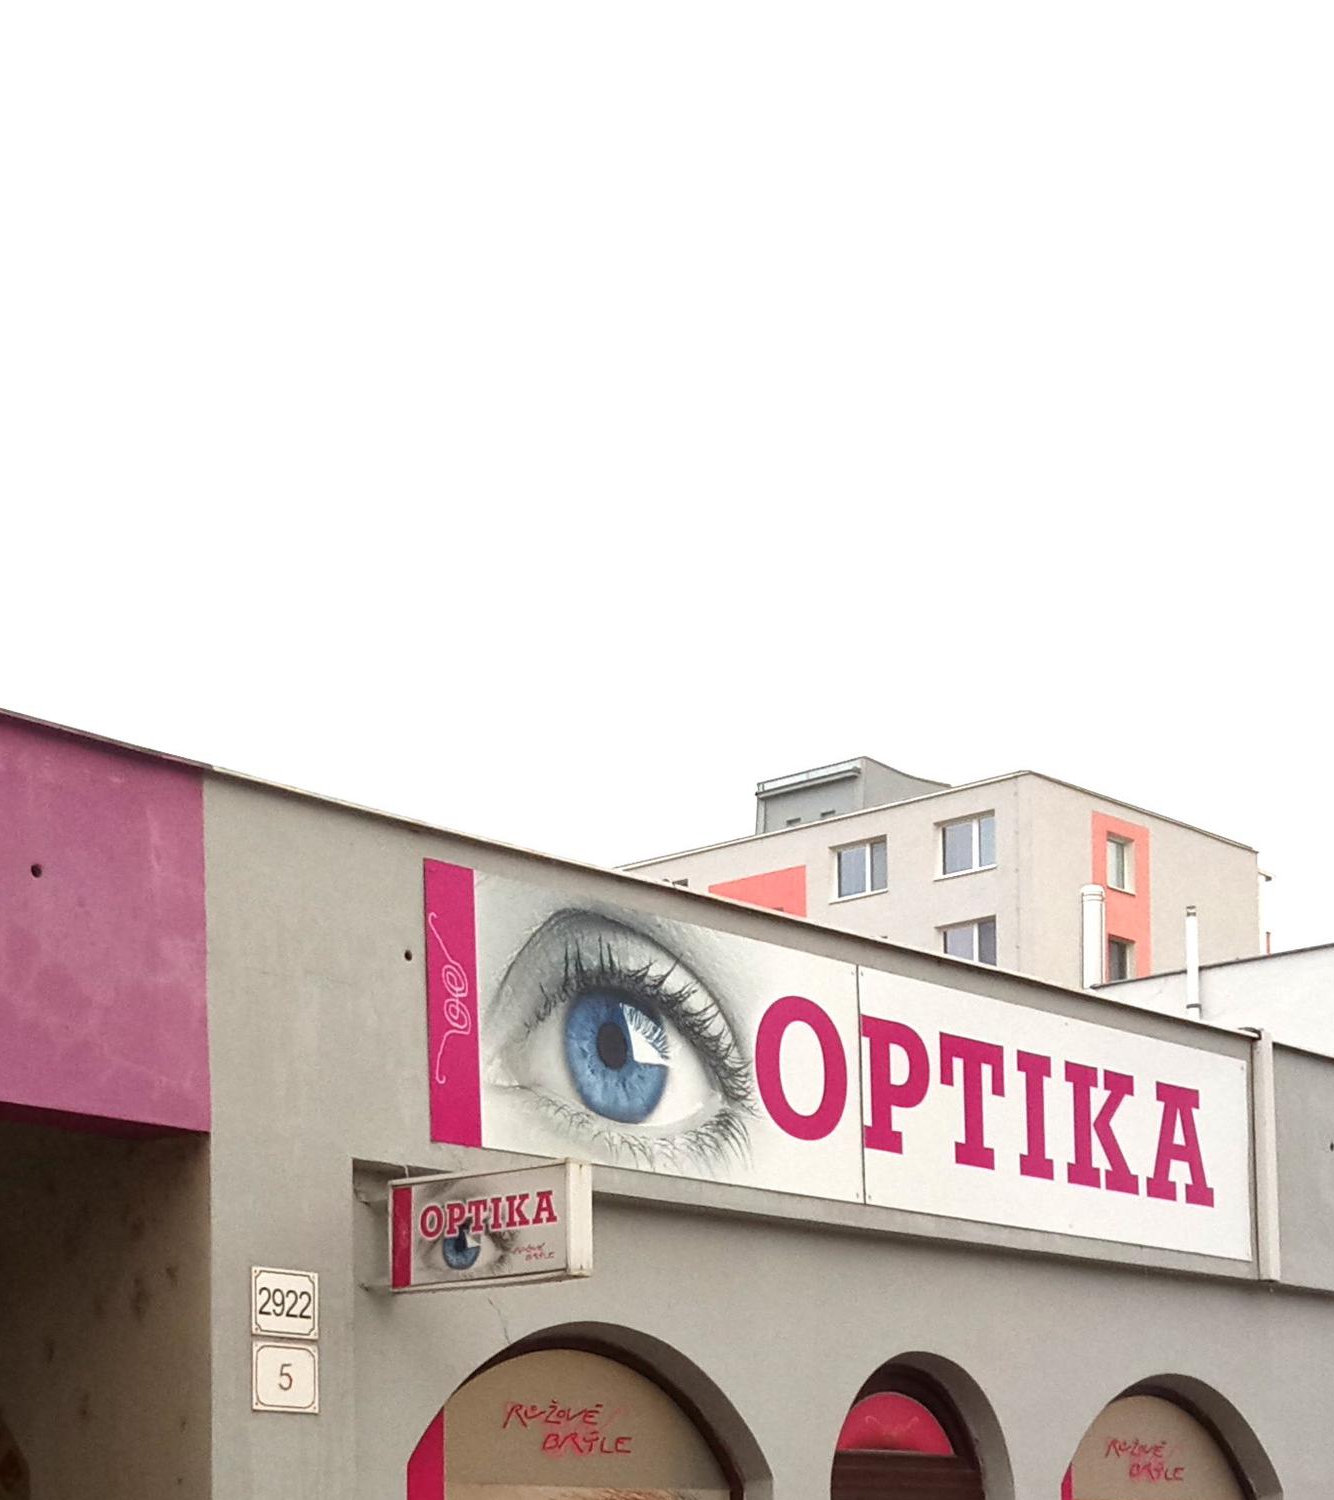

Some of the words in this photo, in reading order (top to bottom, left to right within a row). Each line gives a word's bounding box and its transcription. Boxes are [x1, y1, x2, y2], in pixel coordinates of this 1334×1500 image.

[754, 995, 1216, 1209] OPTIKA
[419, 1189, 558, 1239] OPTIKA
[258, 1286, 313, 1320] 2922
[278, 1363, 294, 1392] 5
